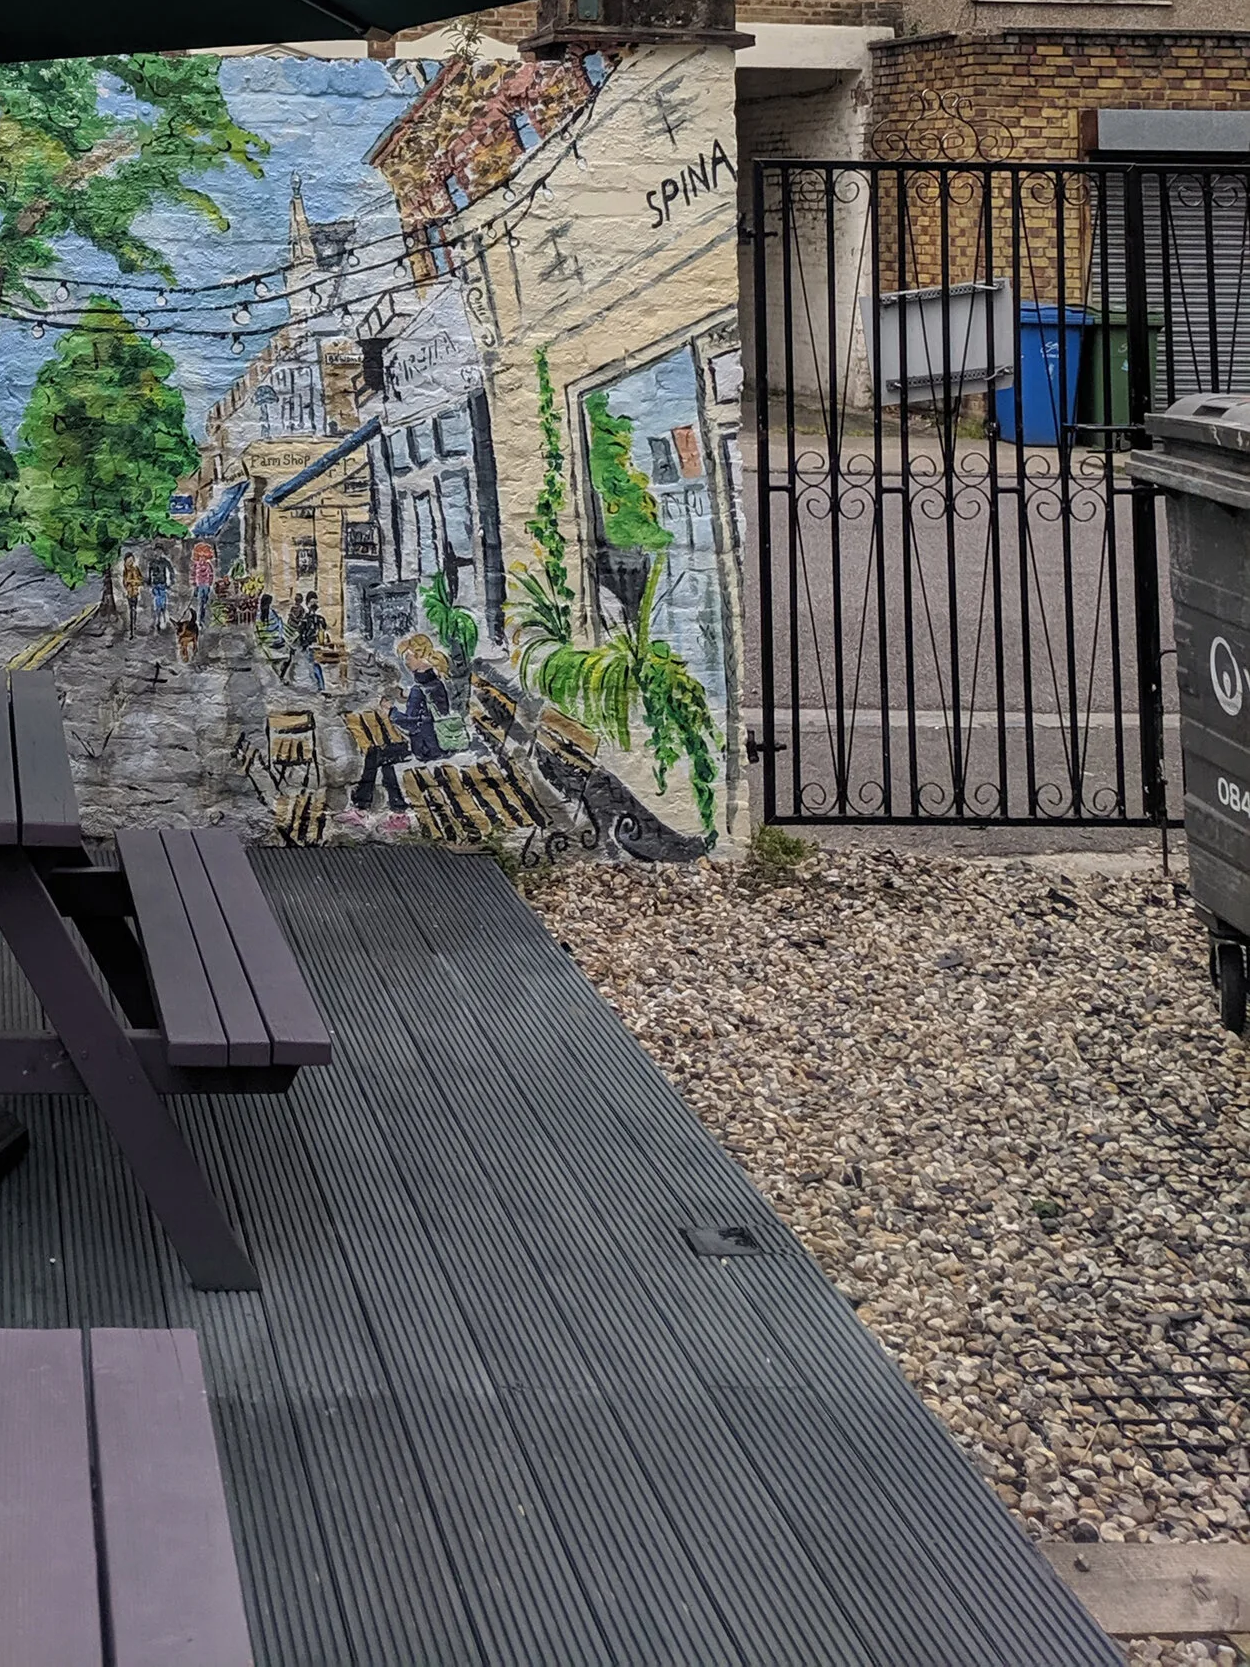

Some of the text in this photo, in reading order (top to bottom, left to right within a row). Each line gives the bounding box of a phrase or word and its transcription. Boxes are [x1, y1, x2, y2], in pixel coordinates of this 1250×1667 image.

[646, 138, 737, 229] SPINA
[251, 454, 311, 468] Farm Shop
